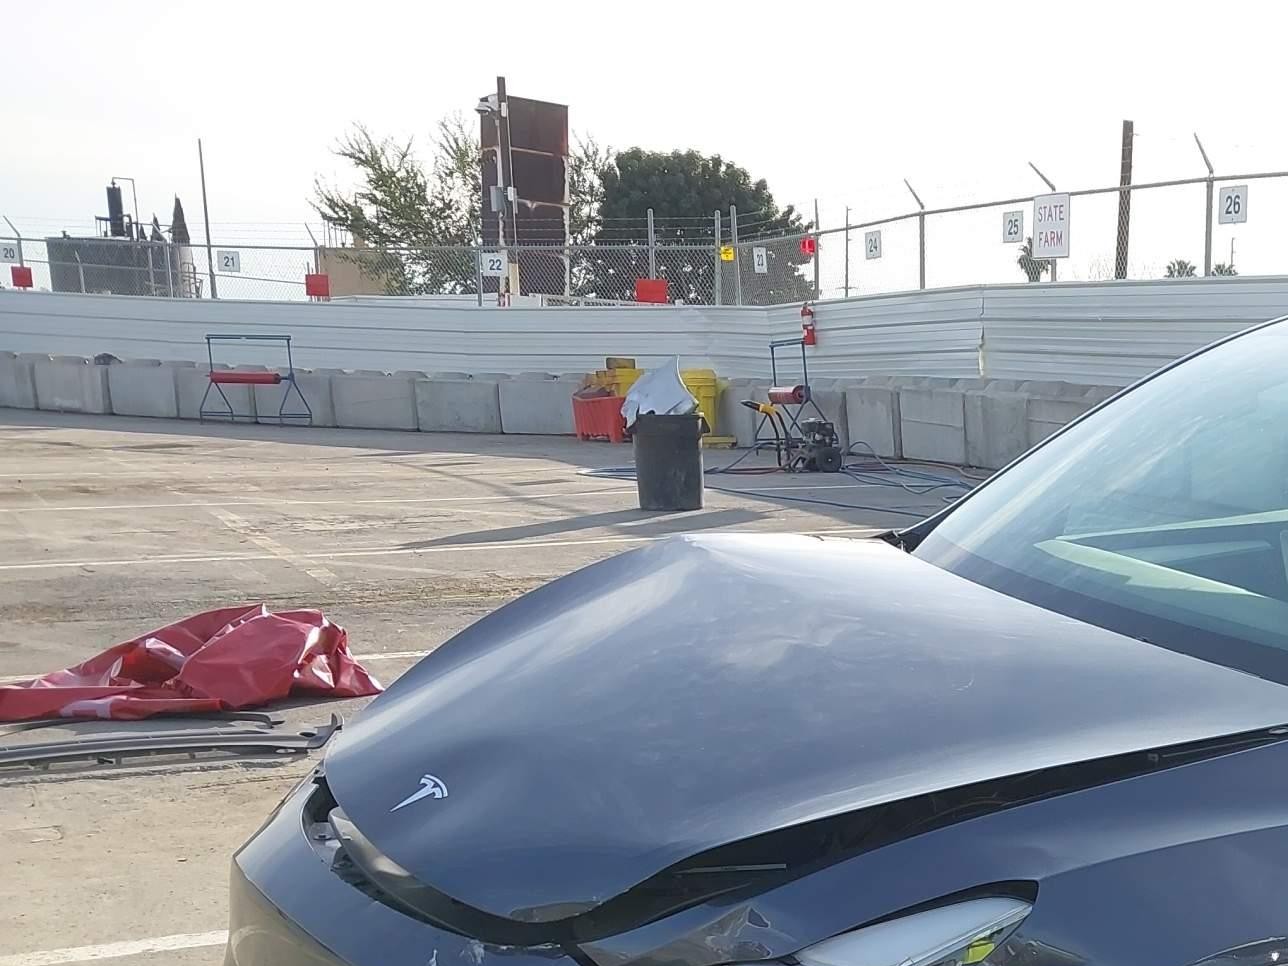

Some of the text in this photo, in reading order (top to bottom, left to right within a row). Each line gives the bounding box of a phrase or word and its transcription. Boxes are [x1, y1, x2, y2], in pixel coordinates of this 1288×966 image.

[1225, 195, 1241, 215] 26
[1038, 204, 1065, 223] STATE
[1008, 219, 1019, 236] 25
[868, 238, 878, 253] 24
[1038, 231, 1063, 248] FARM
[4, 248, 15, 259] 20
[757, 254, 764, 267] 23
[223, 256, 235, 267] 21
[489, 259, 502, 271] 22
